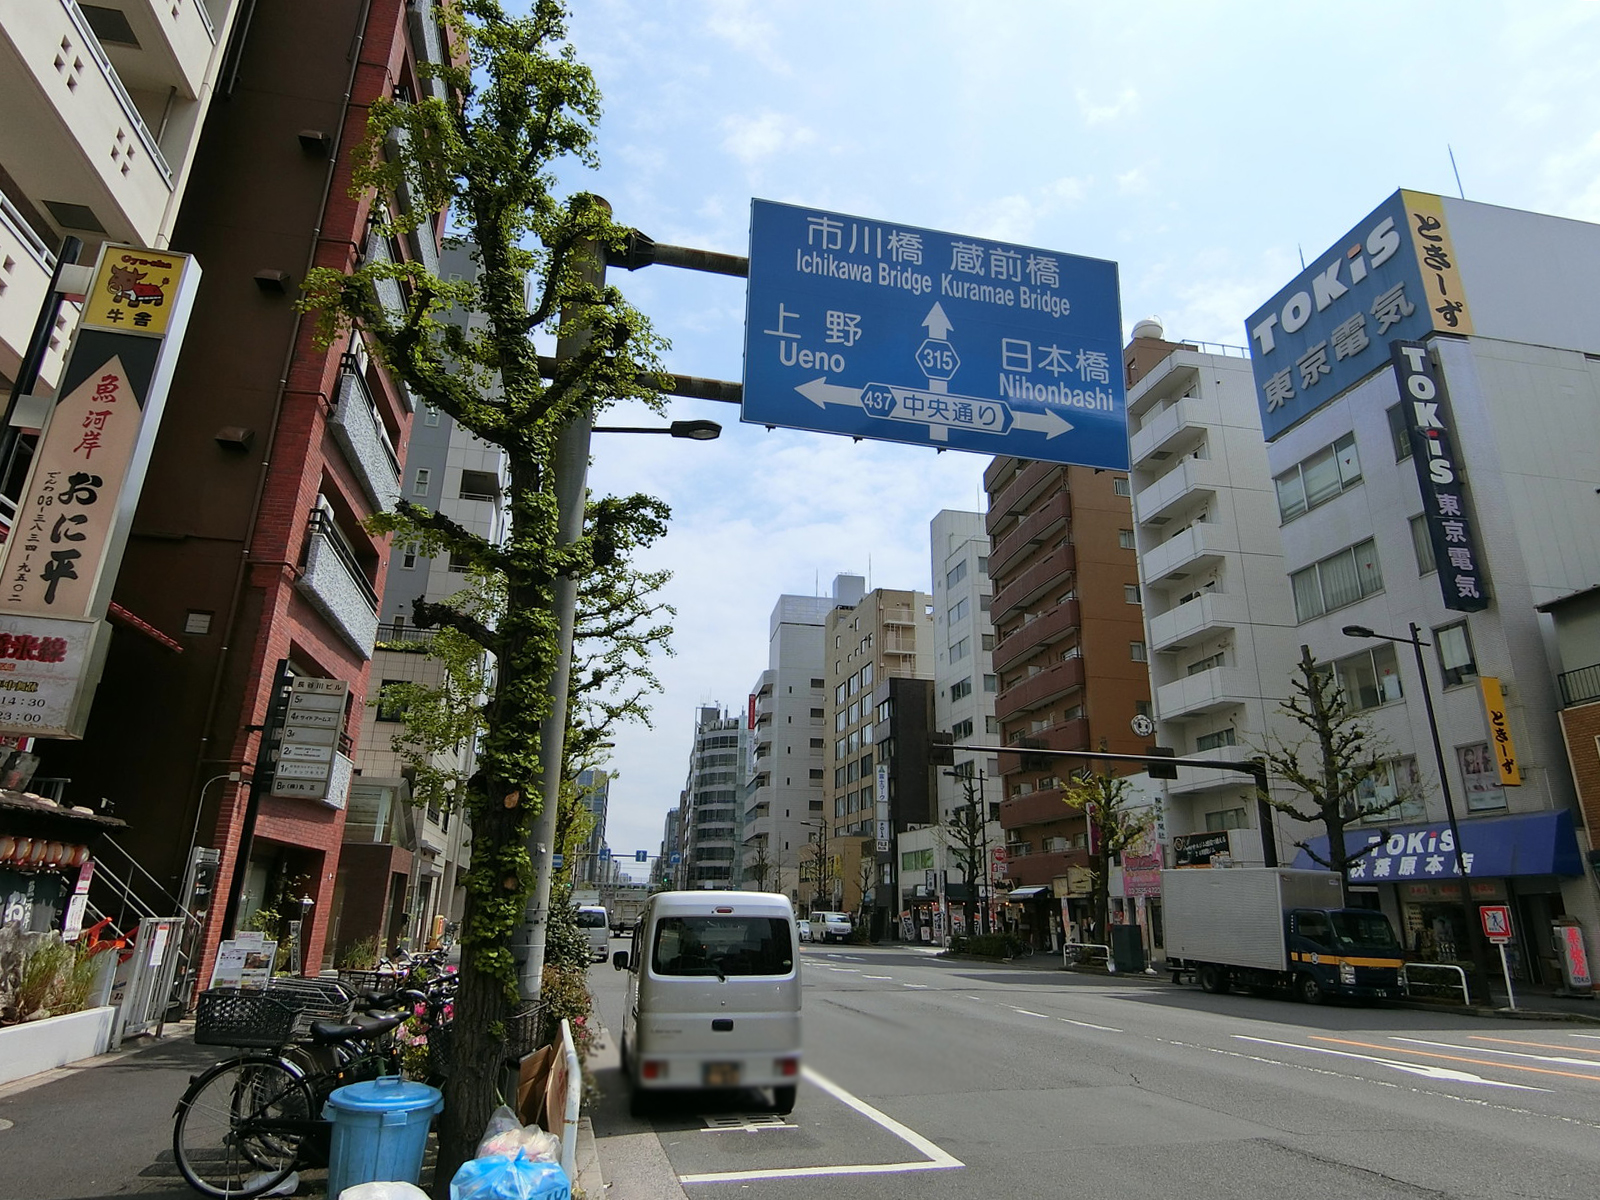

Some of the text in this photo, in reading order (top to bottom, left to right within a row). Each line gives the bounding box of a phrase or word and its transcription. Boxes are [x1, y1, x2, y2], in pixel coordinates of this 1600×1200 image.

[807, 216, 1060, 289] 市川橋 蔵前橋
[796, 248, 1070, 318] Ichikawa Bridge Kuramae Bridge
[763, 302, 862, 347] 上野
[778, 340, 846, 374] Ueno
[923, 348, 953, 371] 315
[1001, 337, 1110, 385] 日本橋
[1262, 280, 1416, 414] 東京電気
[864, 390, 892, 410] 437
[902, 395, 997, 426] 中央通り
[999, 373, 1114, 412] Nihonbashi
[73, 373, 120, 460] 魚河岸
[40, 471, 103, 604] おに平
[1435, 493, 1480, 600] 東京電気
[294, 695, 303, 704] 5F
[297, 681, 342, 691] 長谷川ビル
[283, 747, 292, 755] 2F
[287, 729, 295, 738] 3F
[1347, 852, 1474, 878] 秋葉原本店
